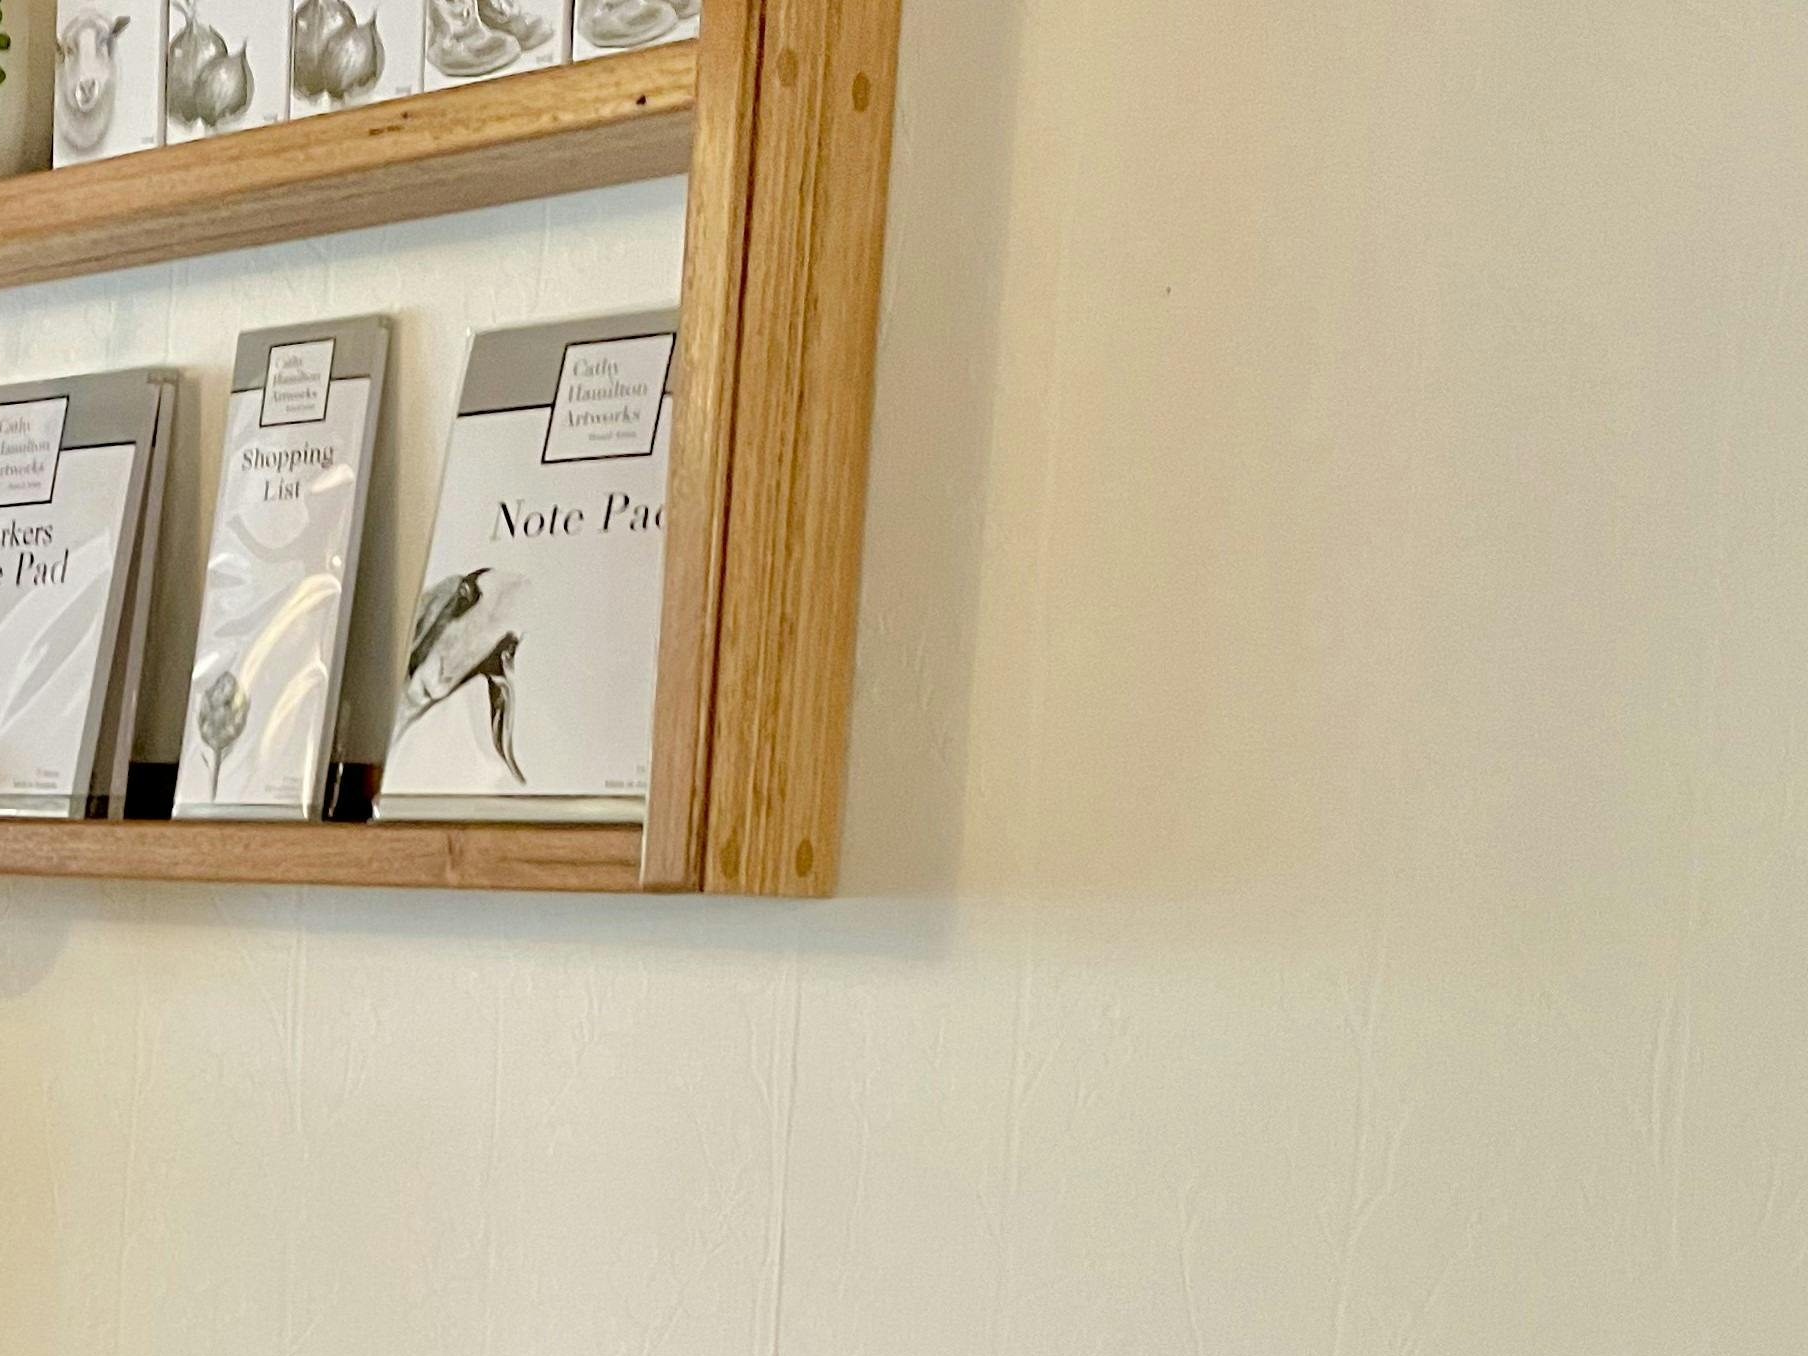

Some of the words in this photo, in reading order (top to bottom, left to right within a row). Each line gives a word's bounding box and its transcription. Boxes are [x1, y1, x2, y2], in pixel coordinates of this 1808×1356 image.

[568, 379, 648, 403] Hamilton
[564, 405, 641, 427] Artworks
[242, 441, 334, 474] Shopping
[263, 477, 301, 501] List
[489, 498, 585, 542] Note
[15, 548, 70, 588] Pad
